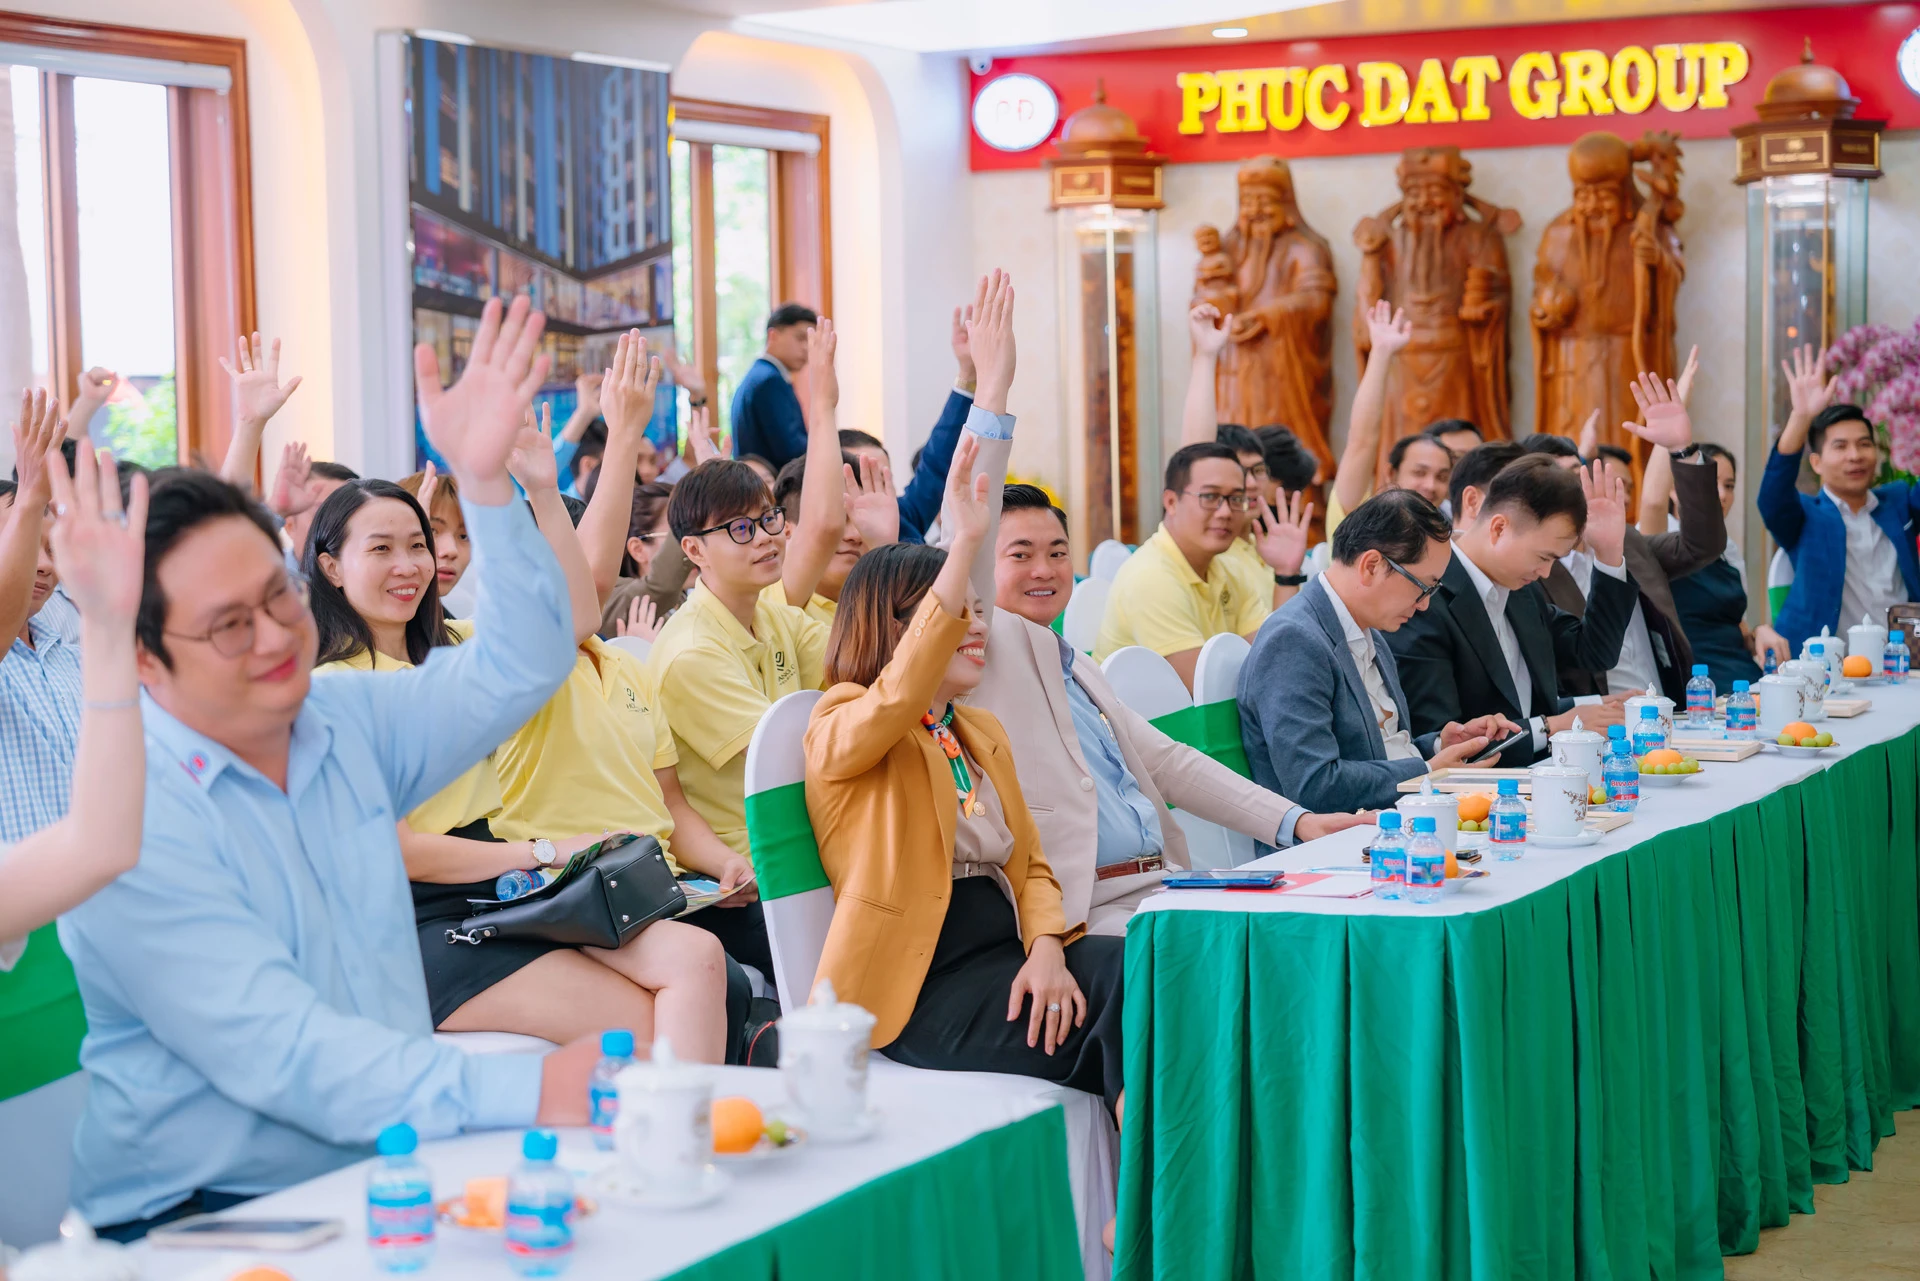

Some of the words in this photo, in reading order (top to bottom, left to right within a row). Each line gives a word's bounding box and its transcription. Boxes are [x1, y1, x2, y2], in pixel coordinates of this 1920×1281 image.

[1177, 64, 1350, 134] PHUC
[1357, 54, 1502, 128] DAT
[1508, 41, 1749, 120] GROUP
